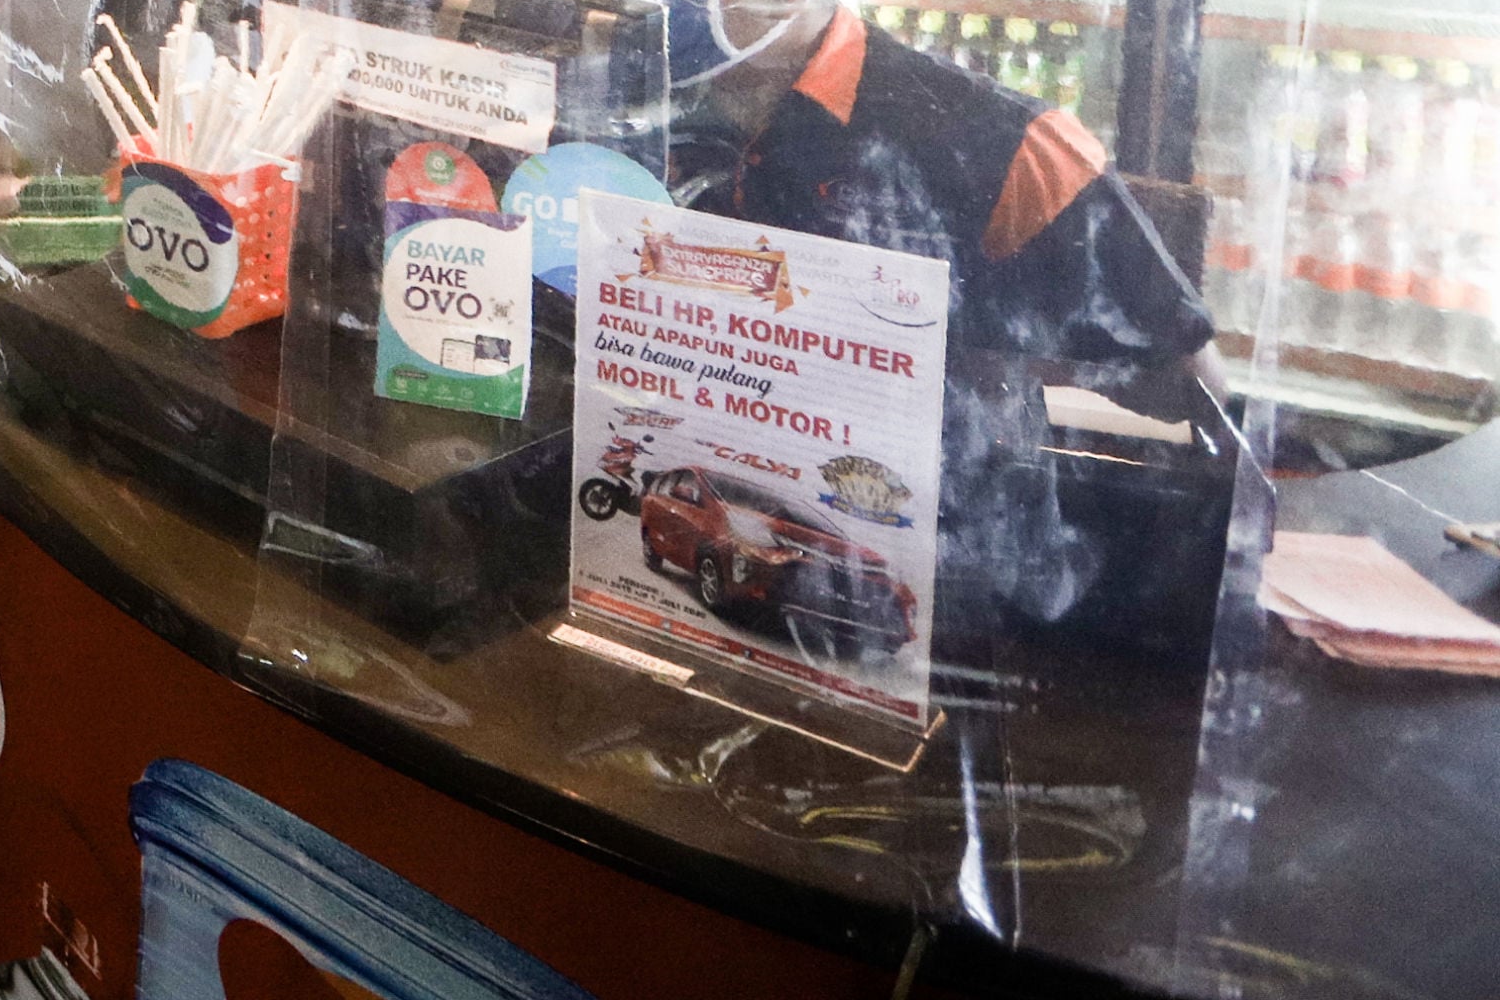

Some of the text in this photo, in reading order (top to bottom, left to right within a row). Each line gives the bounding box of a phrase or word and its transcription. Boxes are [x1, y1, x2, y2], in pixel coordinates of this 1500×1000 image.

[366, 51, 435, 84] STRUK
[440, 68, 508, 102] KASIR
[409, 82, 470, 112] UNTUK
[476, 101, 529, 126] ANDA
[127, 217, 210, 273] OVO
[407, 239, 486, 268] BAYAR
[406, 262, 468, 290] PAKE
[404, 286, 483, 320] OVO
[597, 313, 800, 377] ATAU APAPUN JUGA
[600, 282, 916, 379] BELI HP, KOMPUTER
[594, 330, 773, 400] bisa bawa pulang
[596, 360, 852, 446] MOBIL & MOTOR !
